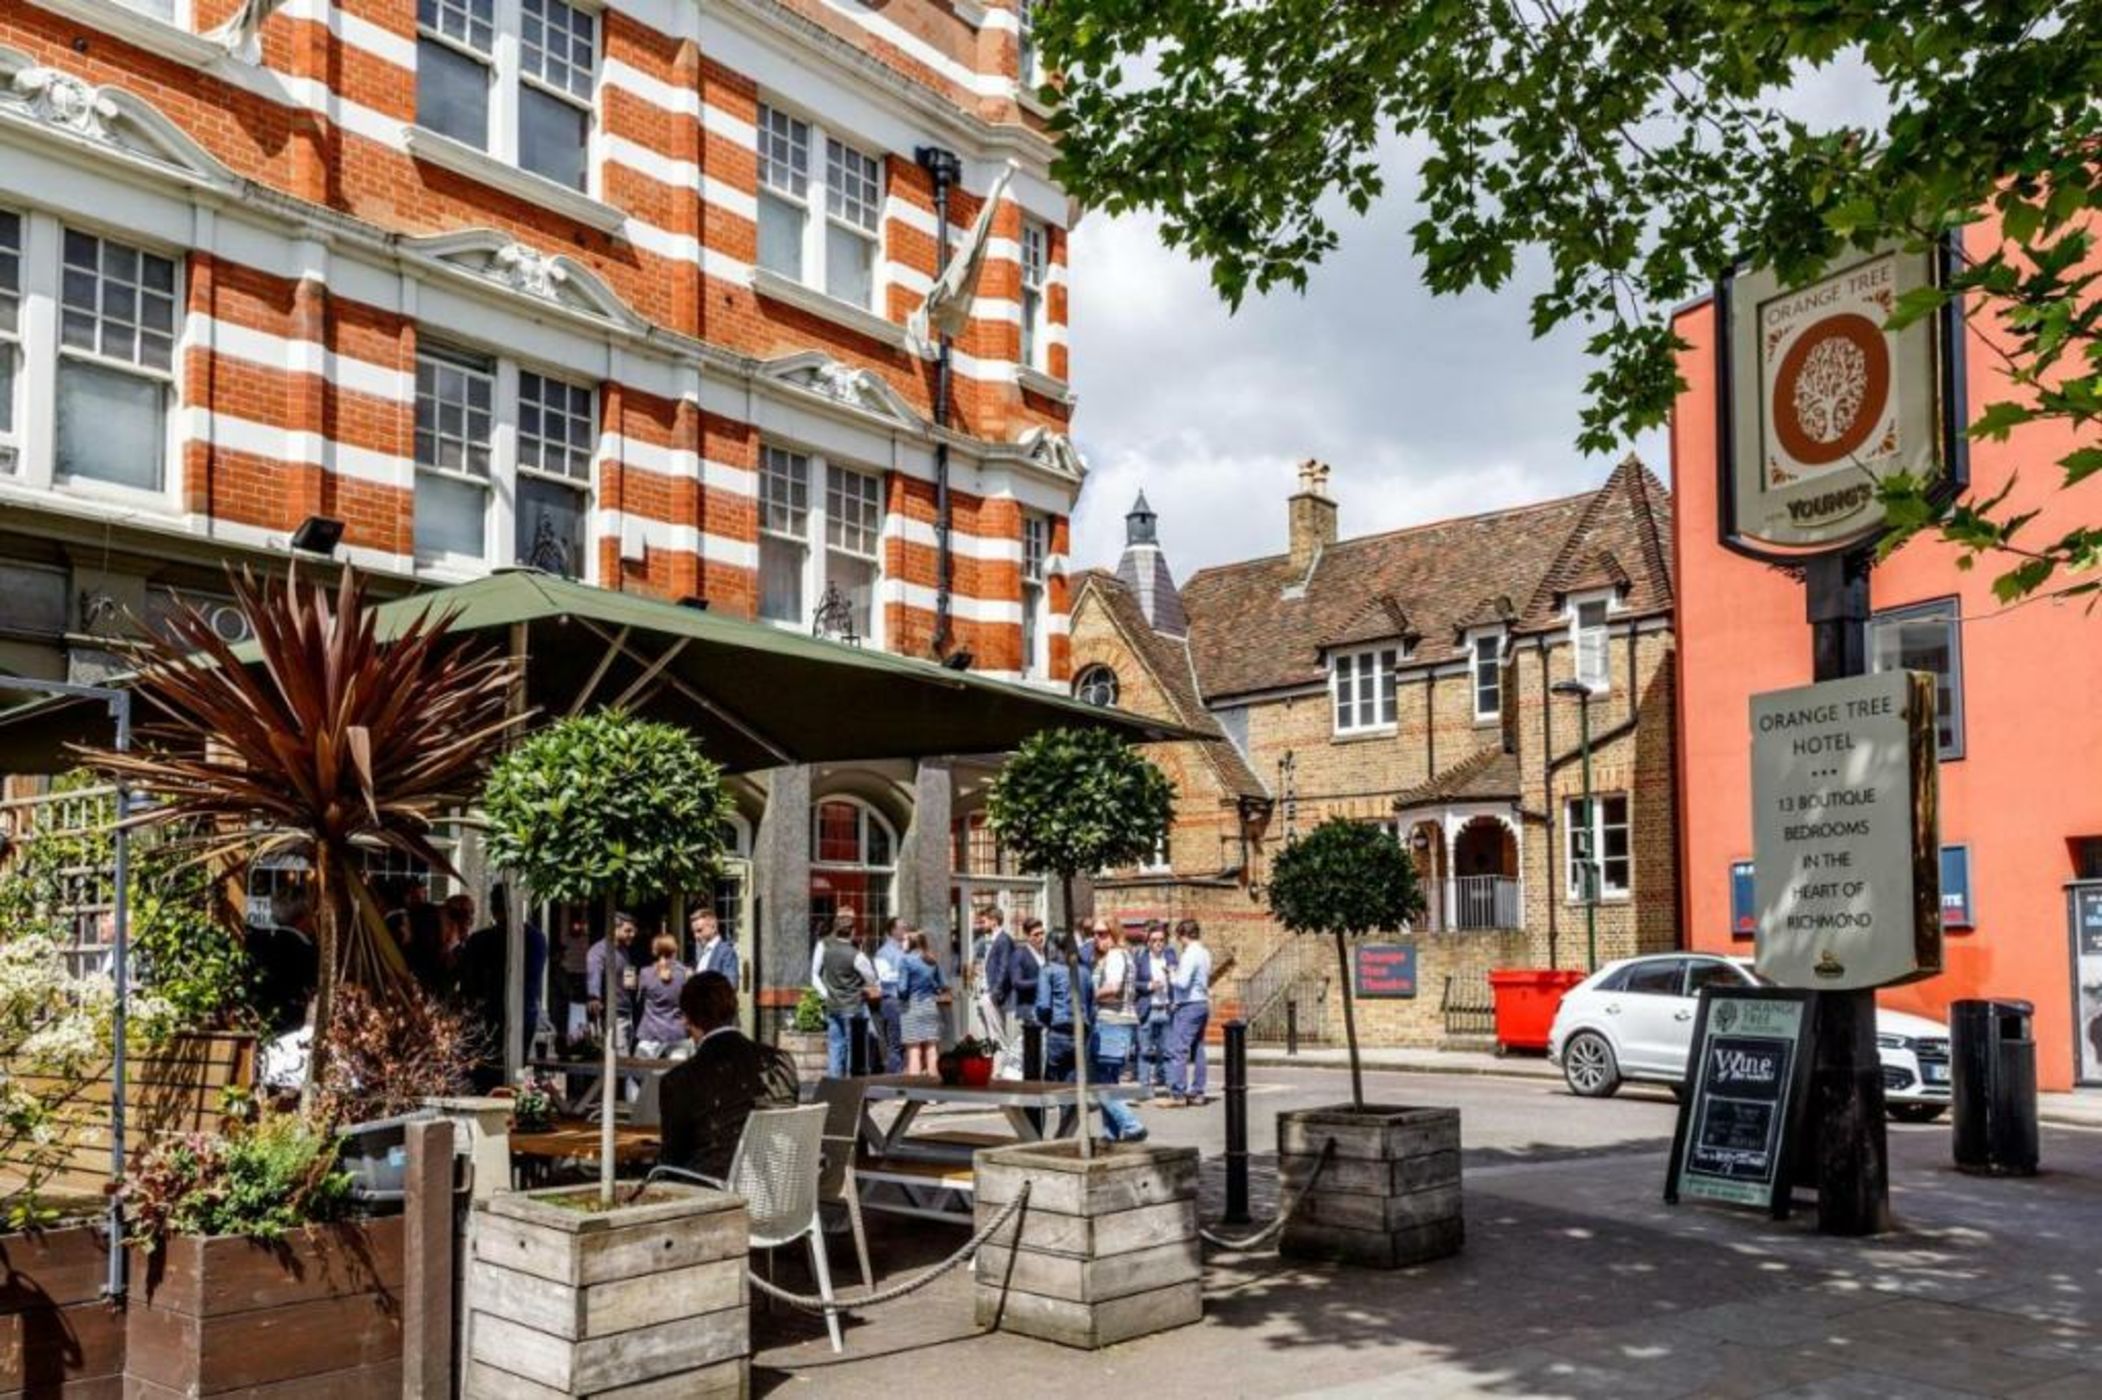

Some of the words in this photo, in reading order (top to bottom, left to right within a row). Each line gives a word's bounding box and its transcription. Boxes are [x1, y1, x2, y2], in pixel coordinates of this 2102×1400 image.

[1767, 284, 1841, 326] ORANGE
[1848, 264, 1891, 295] TREE
[1759, 705, 1839, 732] ORANGE
[1845, 695, 1892, 719] TREE
[1793, 731, 1856, 755] HOTEL
[1779, 796, 1794, 812] 13
[1798, 788, 1876, 810] BOUTIQUE
[1784, 820, 1870, 841] BEDROOMS
[1803, 853, 1820, 869] IN
[1821, 851, 1852, 868] THE
[1793, 882, 1838, 900] HEART
[1842, 881, 1864, 898] OF
[1787, 912, 1872, 930] RICHMOND
[1715, 1049, 1773, 1073] Wine
